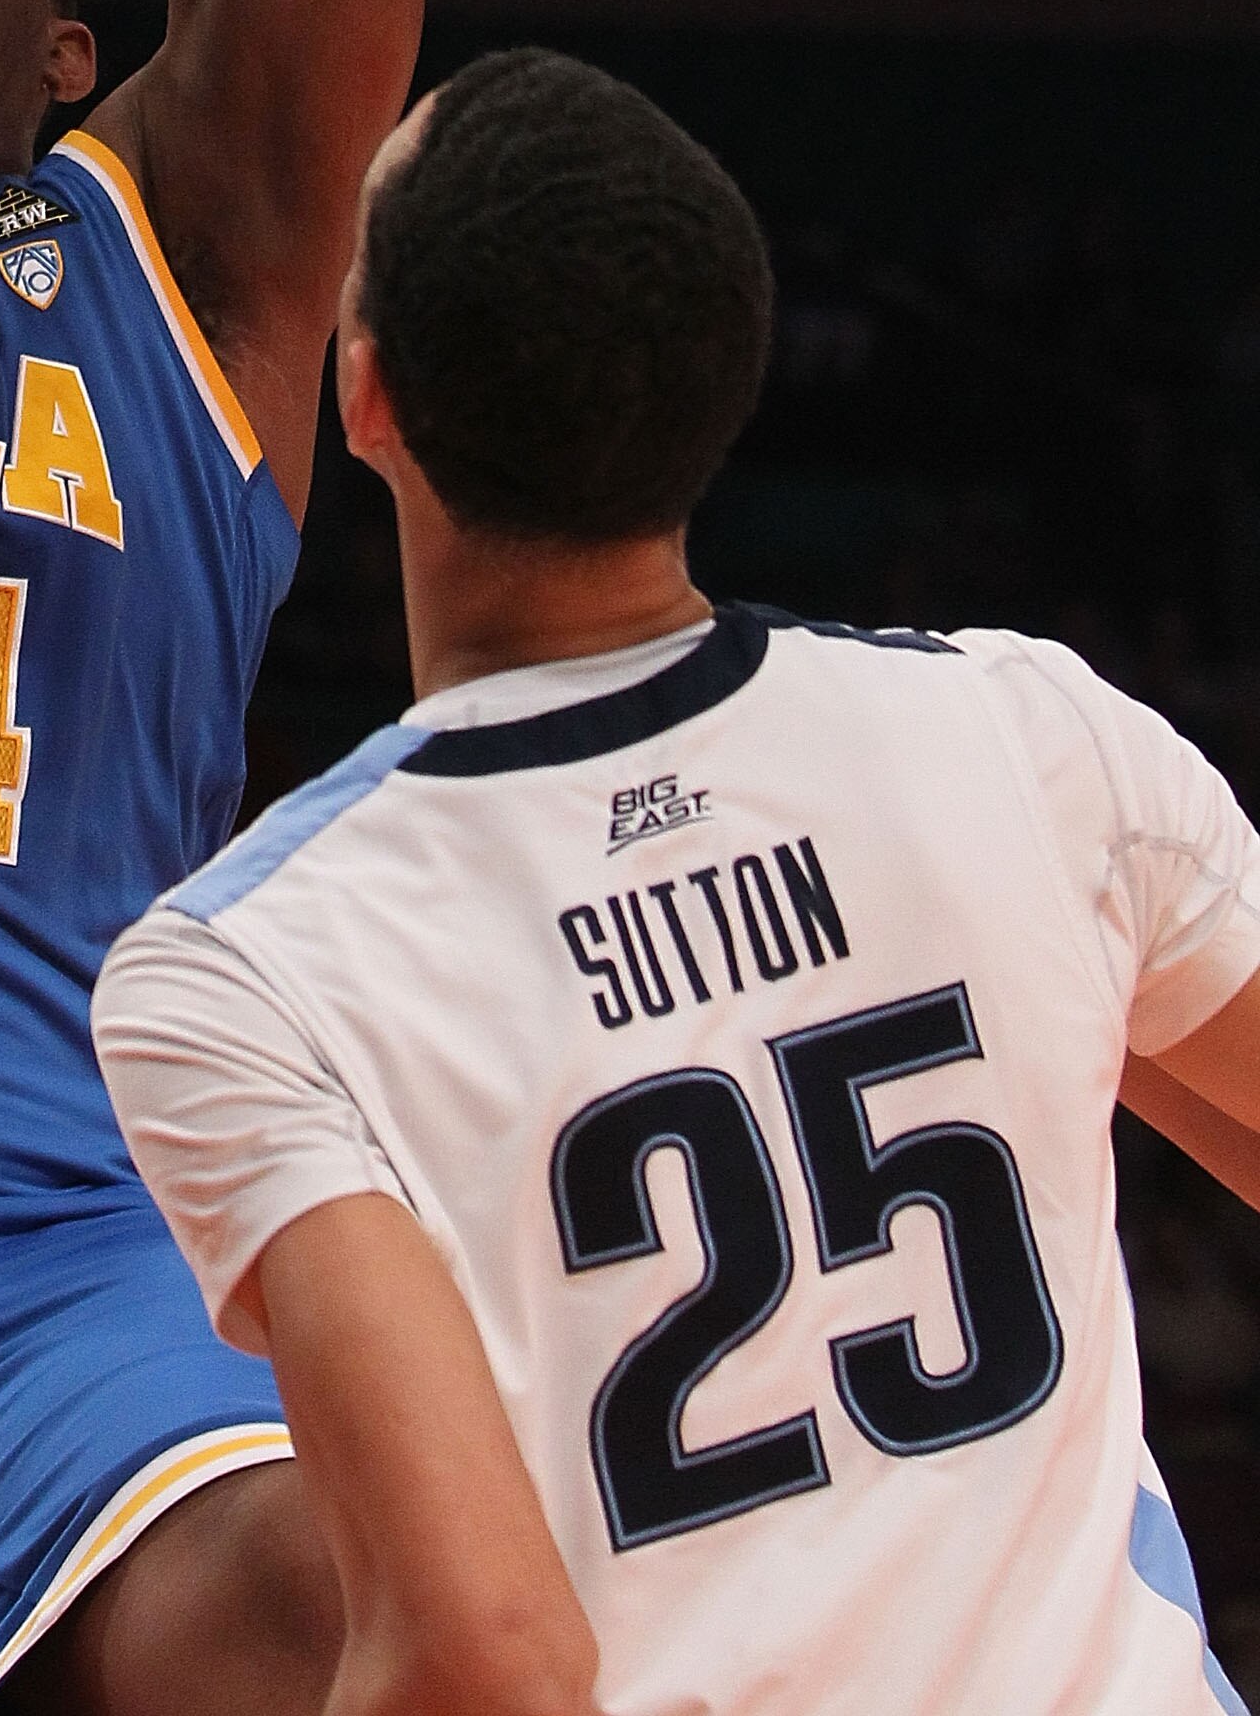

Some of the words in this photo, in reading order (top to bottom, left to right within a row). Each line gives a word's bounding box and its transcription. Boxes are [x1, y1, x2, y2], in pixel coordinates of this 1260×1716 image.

[610, 789, 710, 840] EAST
[612, 772, 678, 815] BIG
[557, 835, 852, 1030] SUTTON
[548, 979, 1065, 1553] 25
